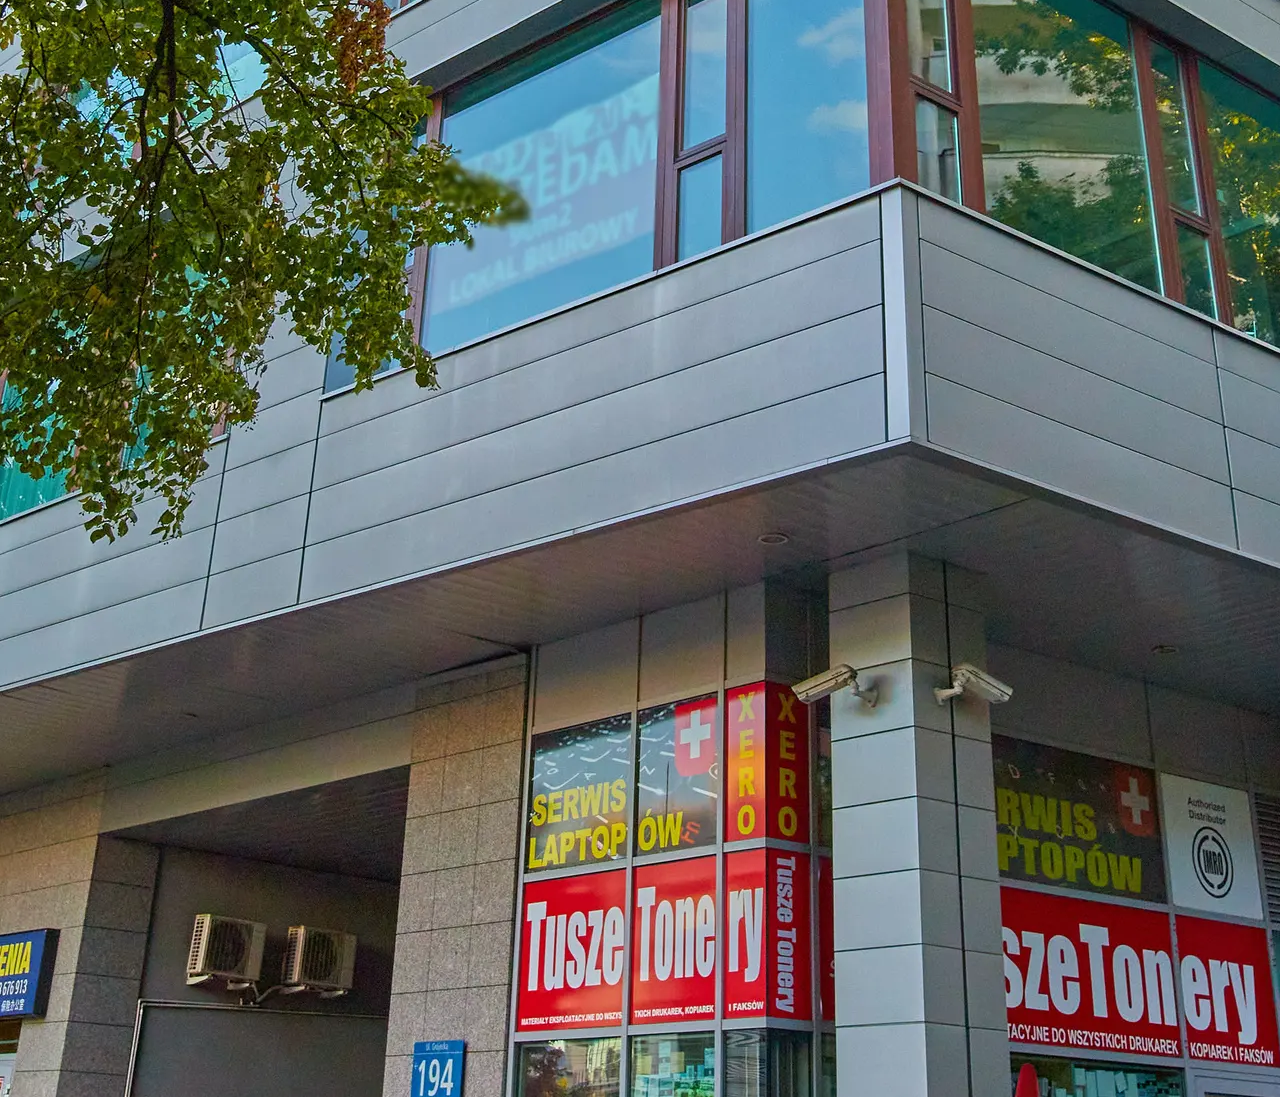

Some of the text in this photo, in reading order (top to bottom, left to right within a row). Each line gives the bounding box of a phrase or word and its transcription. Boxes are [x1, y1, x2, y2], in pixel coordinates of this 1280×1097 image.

[450, 258, 519, 303] LOKAL
[737, 693, 756, 836] XERO
[778, 692, 798, 837] XERO
[532, 778, 627, 827] SERWIS
[996, 787, 1097, 841] RWIS
[1187, 797, 1226, 813] Authorized
[1188, 809, 1226, 824] Distributor
[997, 833, 1142, 893] PTOPÓW
[527, 886, 763, 992] Tusze Tonery
[776, 856, 796, 1013] Tusze Tonery
[2, 981, 14, 996] 676
[15, 979, 28, 994] 913
[1002, 923, 1258, 1045] sze Tonery
[595, 1012, 603, 1021] DO
[732, 1000, 764, 1011] FAKSÓW
[1051, 1027, 1066, 1043] DO
[1067, 1029, 1128, 1049] WSZYSTKICH
[1129, 1035, 1179, 1055] DRUKAREK
[1190, 1042, 1234, 1061] KOPIAREK
[1239, 1046, 1274, 1064] FAKSÓW
[418, 1059, 454, 1097] 194
